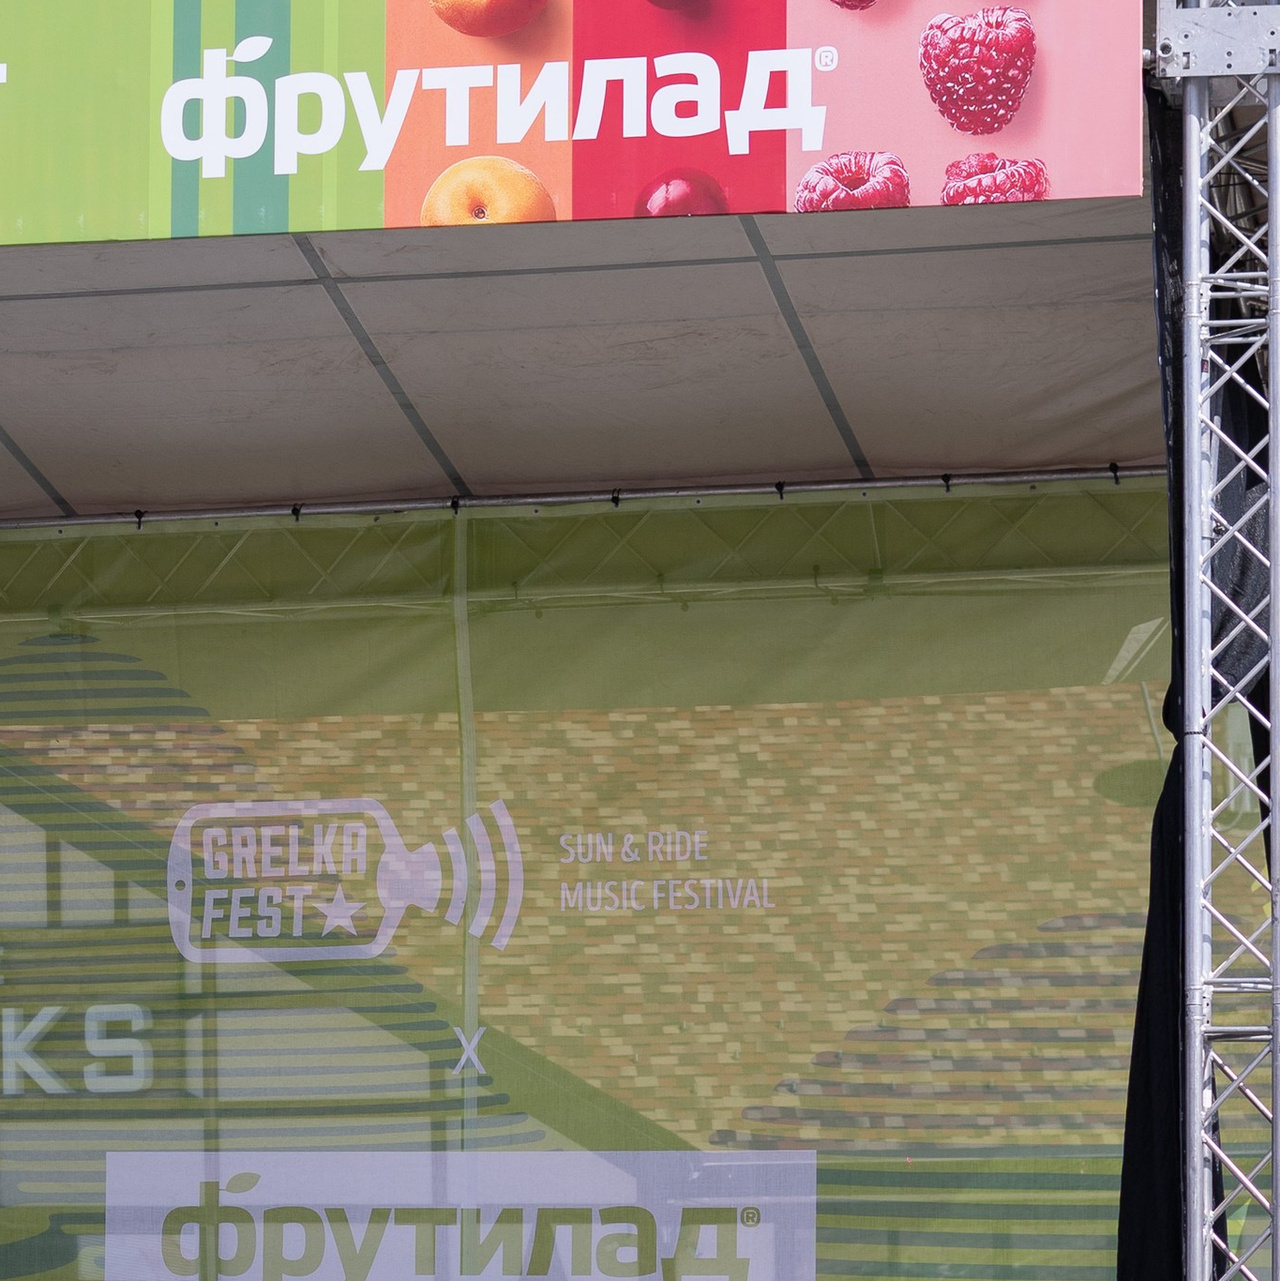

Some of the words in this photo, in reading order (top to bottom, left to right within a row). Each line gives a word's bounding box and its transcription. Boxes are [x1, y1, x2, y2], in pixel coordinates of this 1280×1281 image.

[203, 821, 368, 880] GRELKA
[559, 831, 612, 865] SUN
[620, 831, 640, 863] &
[648, 829, 709, 862] RIDE
[202, 883, 314, 939] FEST
[559, 880, 648, 913] MUSIC
[652, 877, 776, 911] FESTIVAL
